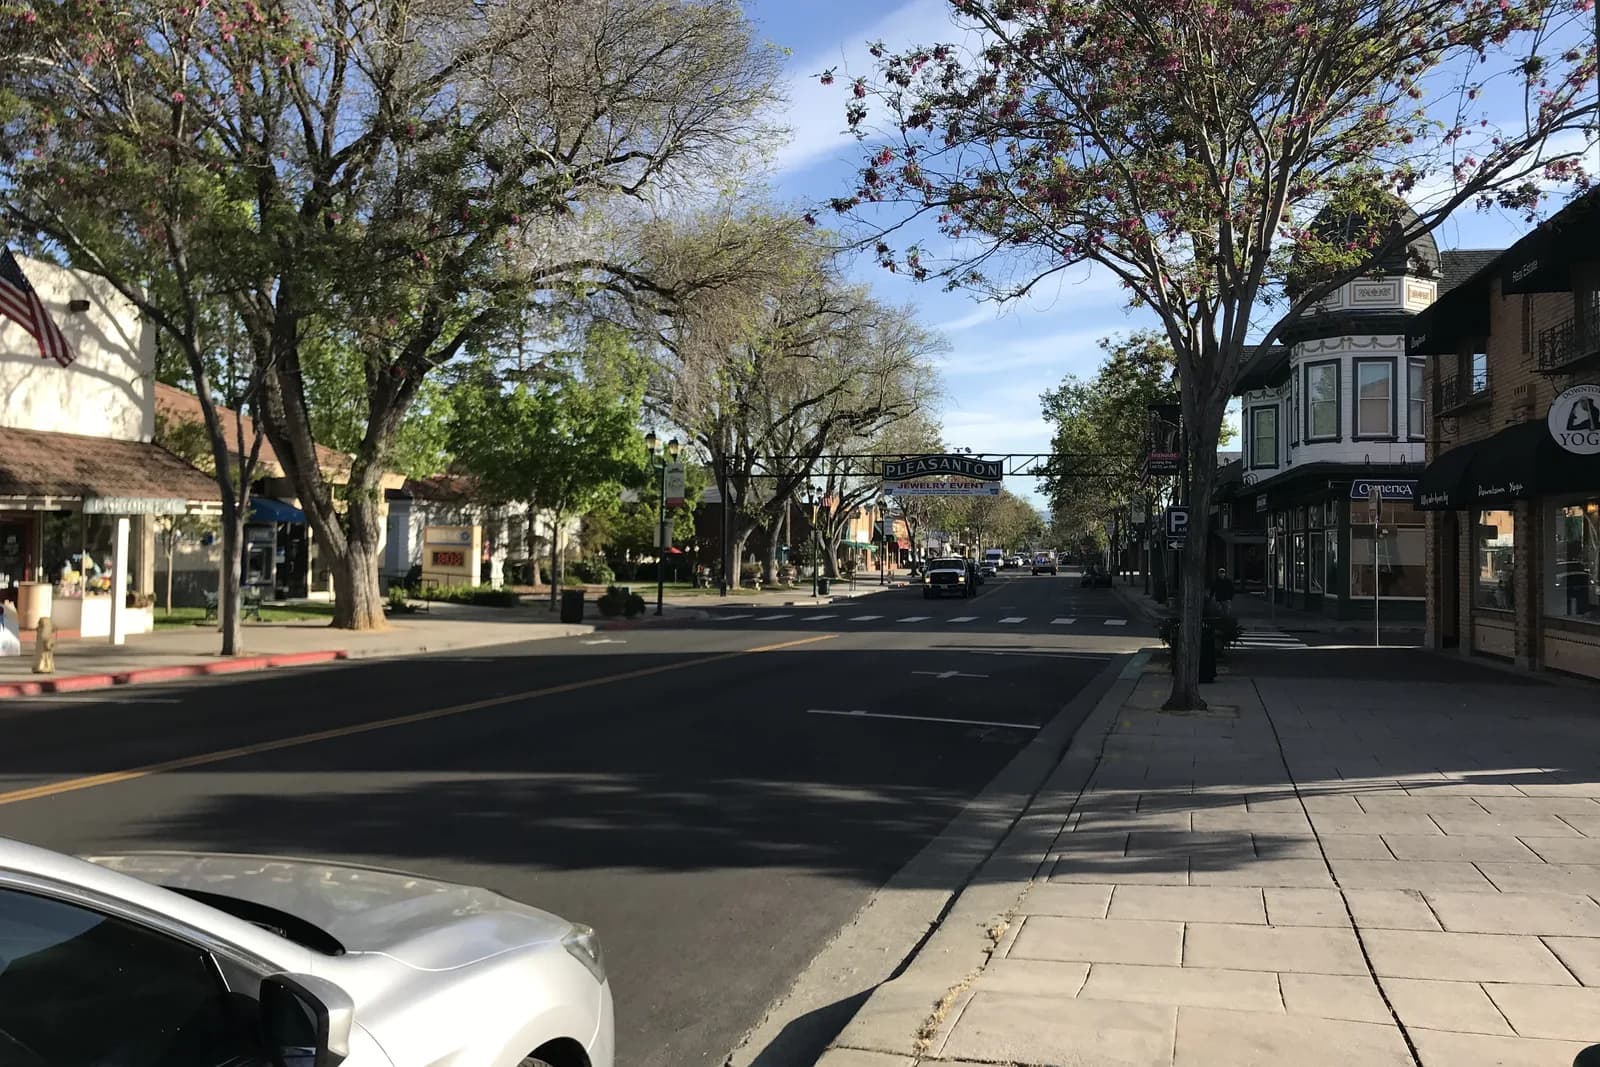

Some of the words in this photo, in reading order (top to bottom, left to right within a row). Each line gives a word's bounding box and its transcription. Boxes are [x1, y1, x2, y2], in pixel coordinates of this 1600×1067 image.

[1562, 386, 1600, 399] DOWNTO
[885, 458, 997, 476] PLEASANTON
[1509, 481, 1523, 495] Yoga
